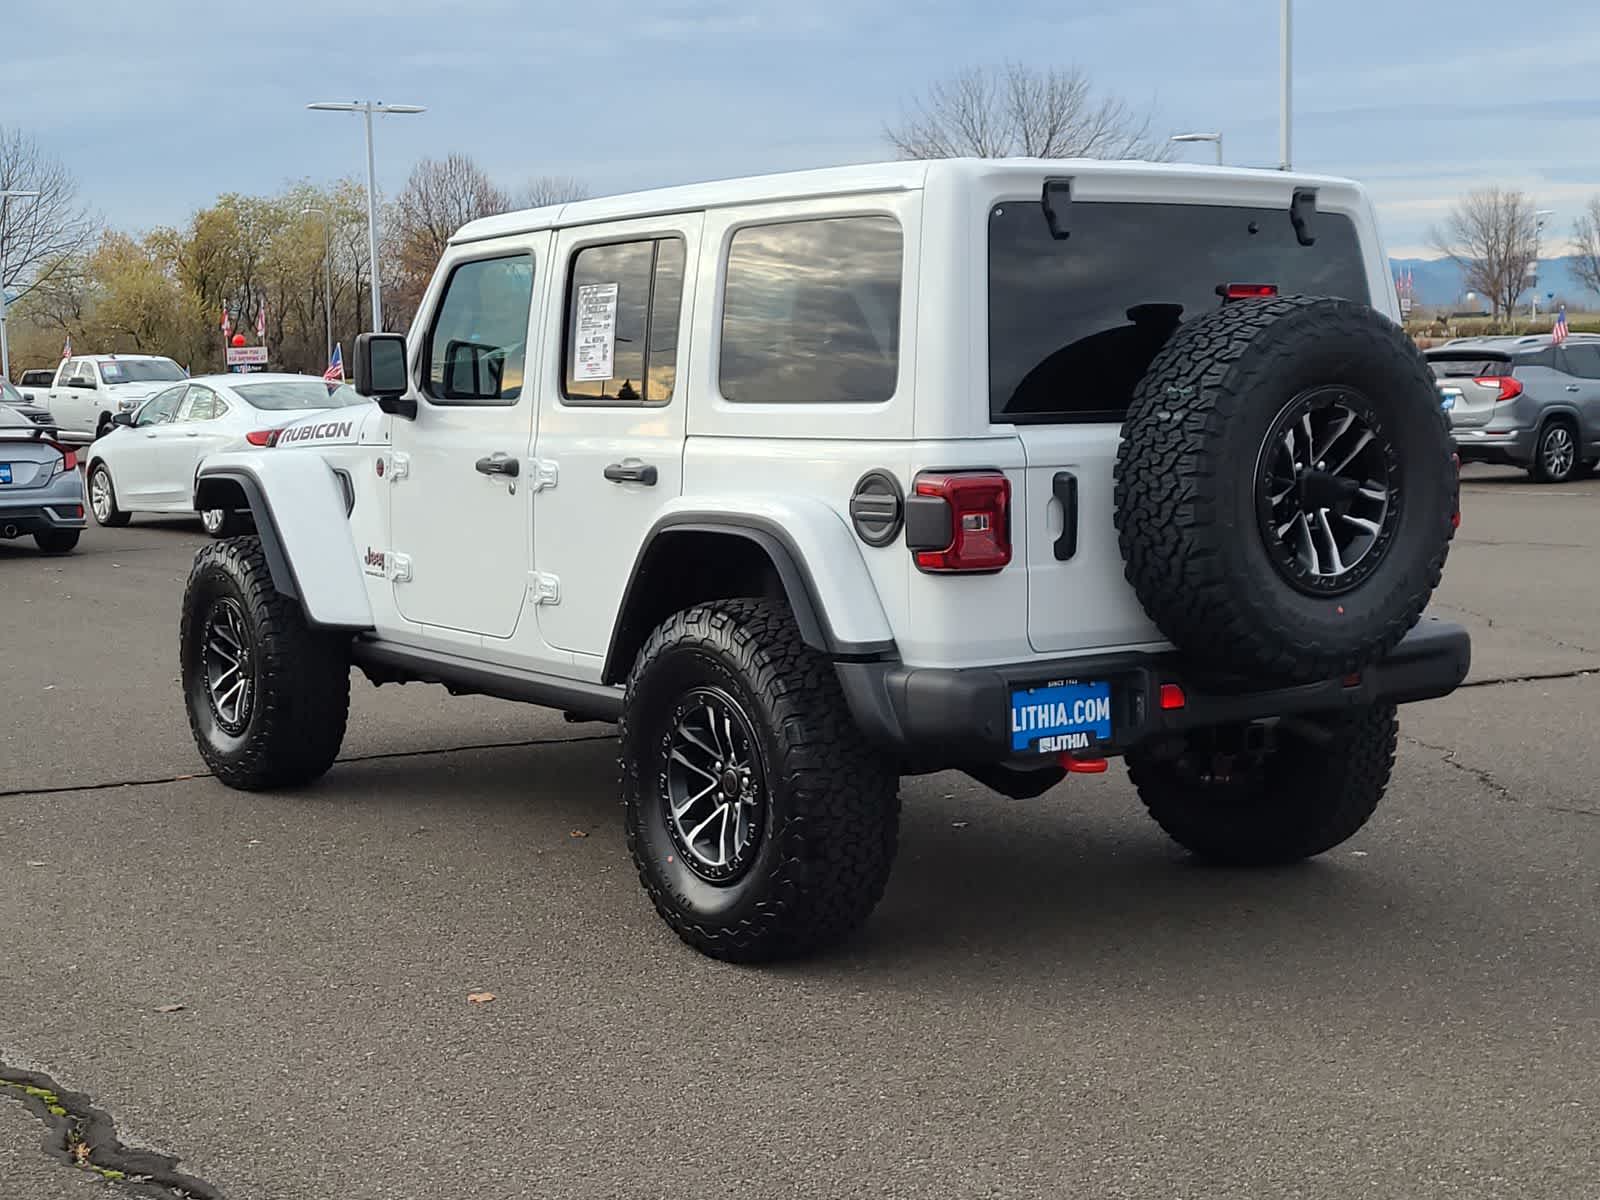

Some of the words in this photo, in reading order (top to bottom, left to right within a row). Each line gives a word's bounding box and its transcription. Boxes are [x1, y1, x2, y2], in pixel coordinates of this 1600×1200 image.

[281, 422, 352, 443] RUBICON
[364, 546, 385, 571] Jeep
[1012, 697, 1110, 732] LITHIA.COM
[1051, 732, 1089, 752] LITHIA
